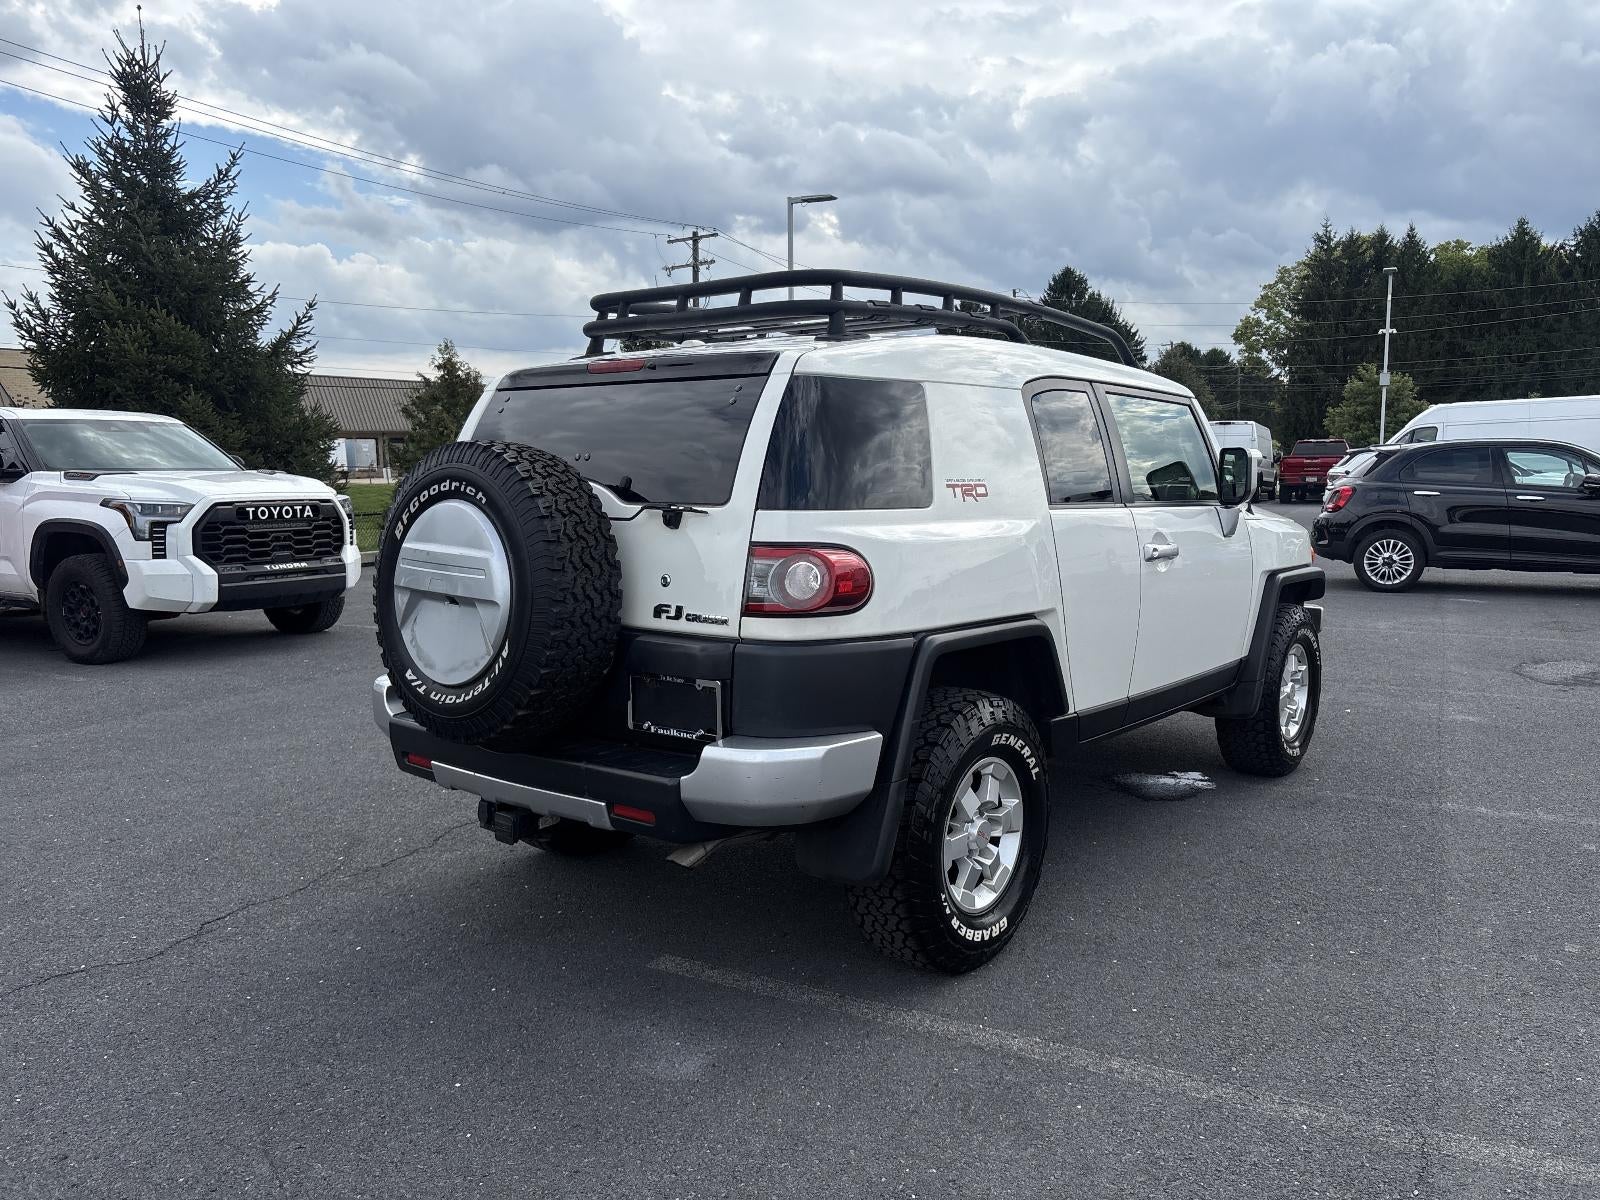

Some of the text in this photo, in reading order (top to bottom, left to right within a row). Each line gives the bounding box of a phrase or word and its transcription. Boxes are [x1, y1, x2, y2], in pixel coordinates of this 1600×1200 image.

[946, 483, 989, 502] TRD
[246, 505, 314, 520] TOYOTA
[395, 479, 487, 540] BFGoodrich
[264, 562, 309, 571] TUNDRA
[653, 603, 729, 626] FJ CRUISER
[650, 725, 697, 740] Faulkner
[991, 733, 1037, 780] GENERAL
[951, 916, 1008, 942] GRABBER
